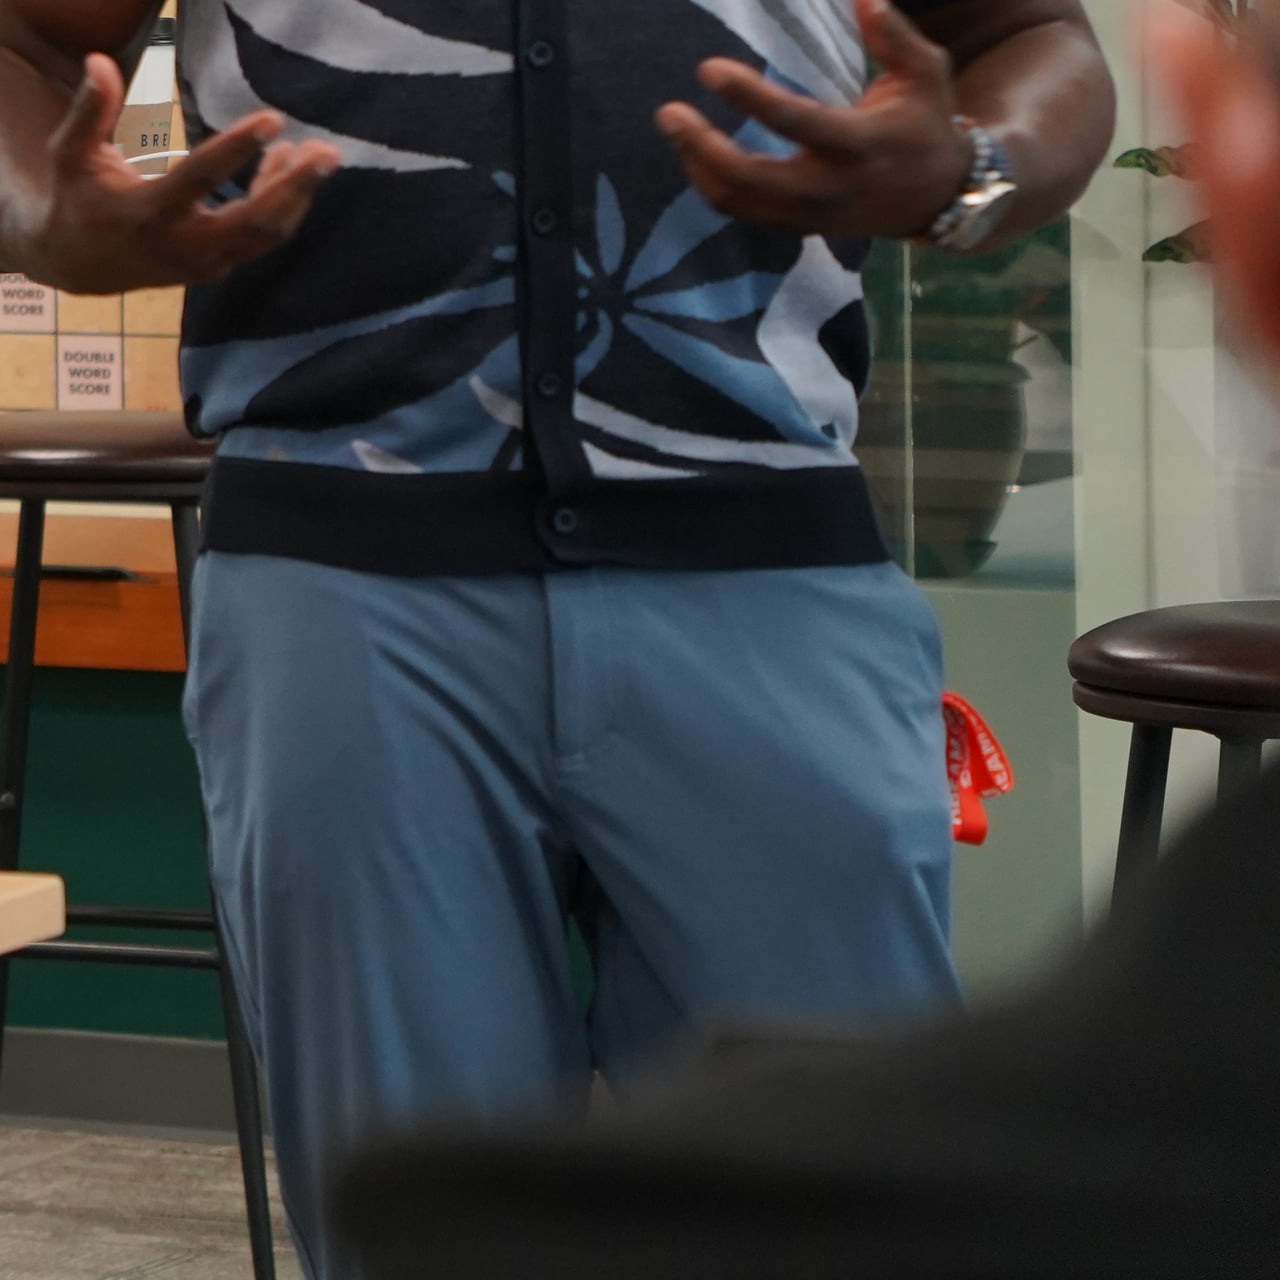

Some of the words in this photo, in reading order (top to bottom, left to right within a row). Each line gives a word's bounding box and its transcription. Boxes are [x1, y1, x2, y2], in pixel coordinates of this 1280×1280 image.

[2, 289, 44, 300] WORD
[3, 305, 44, 316] SCORE
[63, 351, 115, 364] DOUBLE
[68, 367, 111, 379] WORD
[69, 383, 111, 395] SCORE
